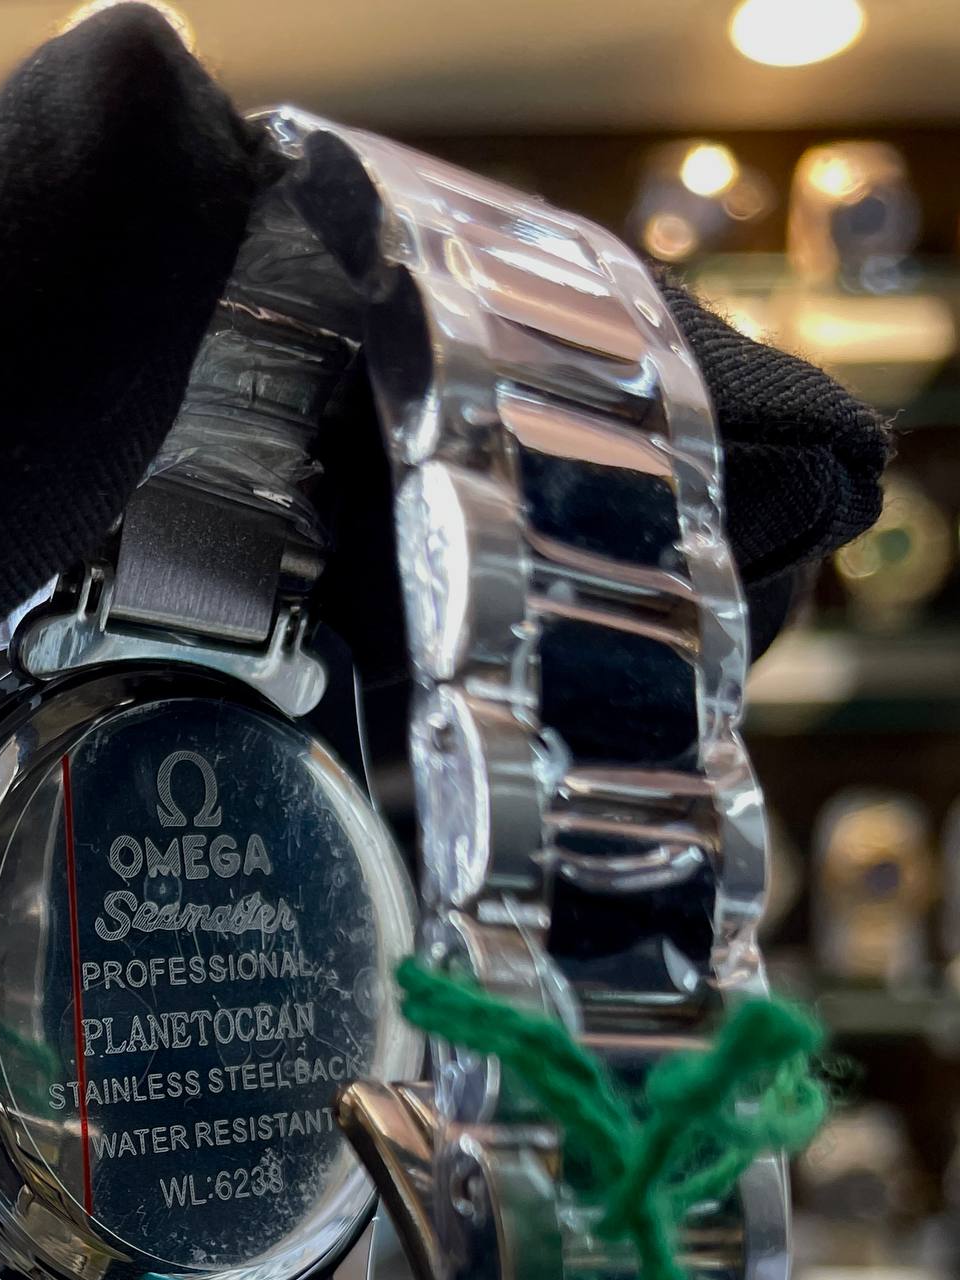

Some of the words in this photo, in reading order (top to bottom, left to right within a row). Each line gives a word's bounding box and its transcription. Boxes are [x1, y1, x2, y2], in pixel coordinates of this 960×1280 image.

[109, 833, 273, 880] OMEGA
[81, 951, 314, 991] PROFESSIONAL
[48, 1070, 202, 1111] STAINLESS
[207, 1062, 293, 1095] STEEL
[294, 1054, 363, 1085] BACK
[90, 1124, 191, 1161] WATER
[195, 1106, 337, 1149] RESISTANT
